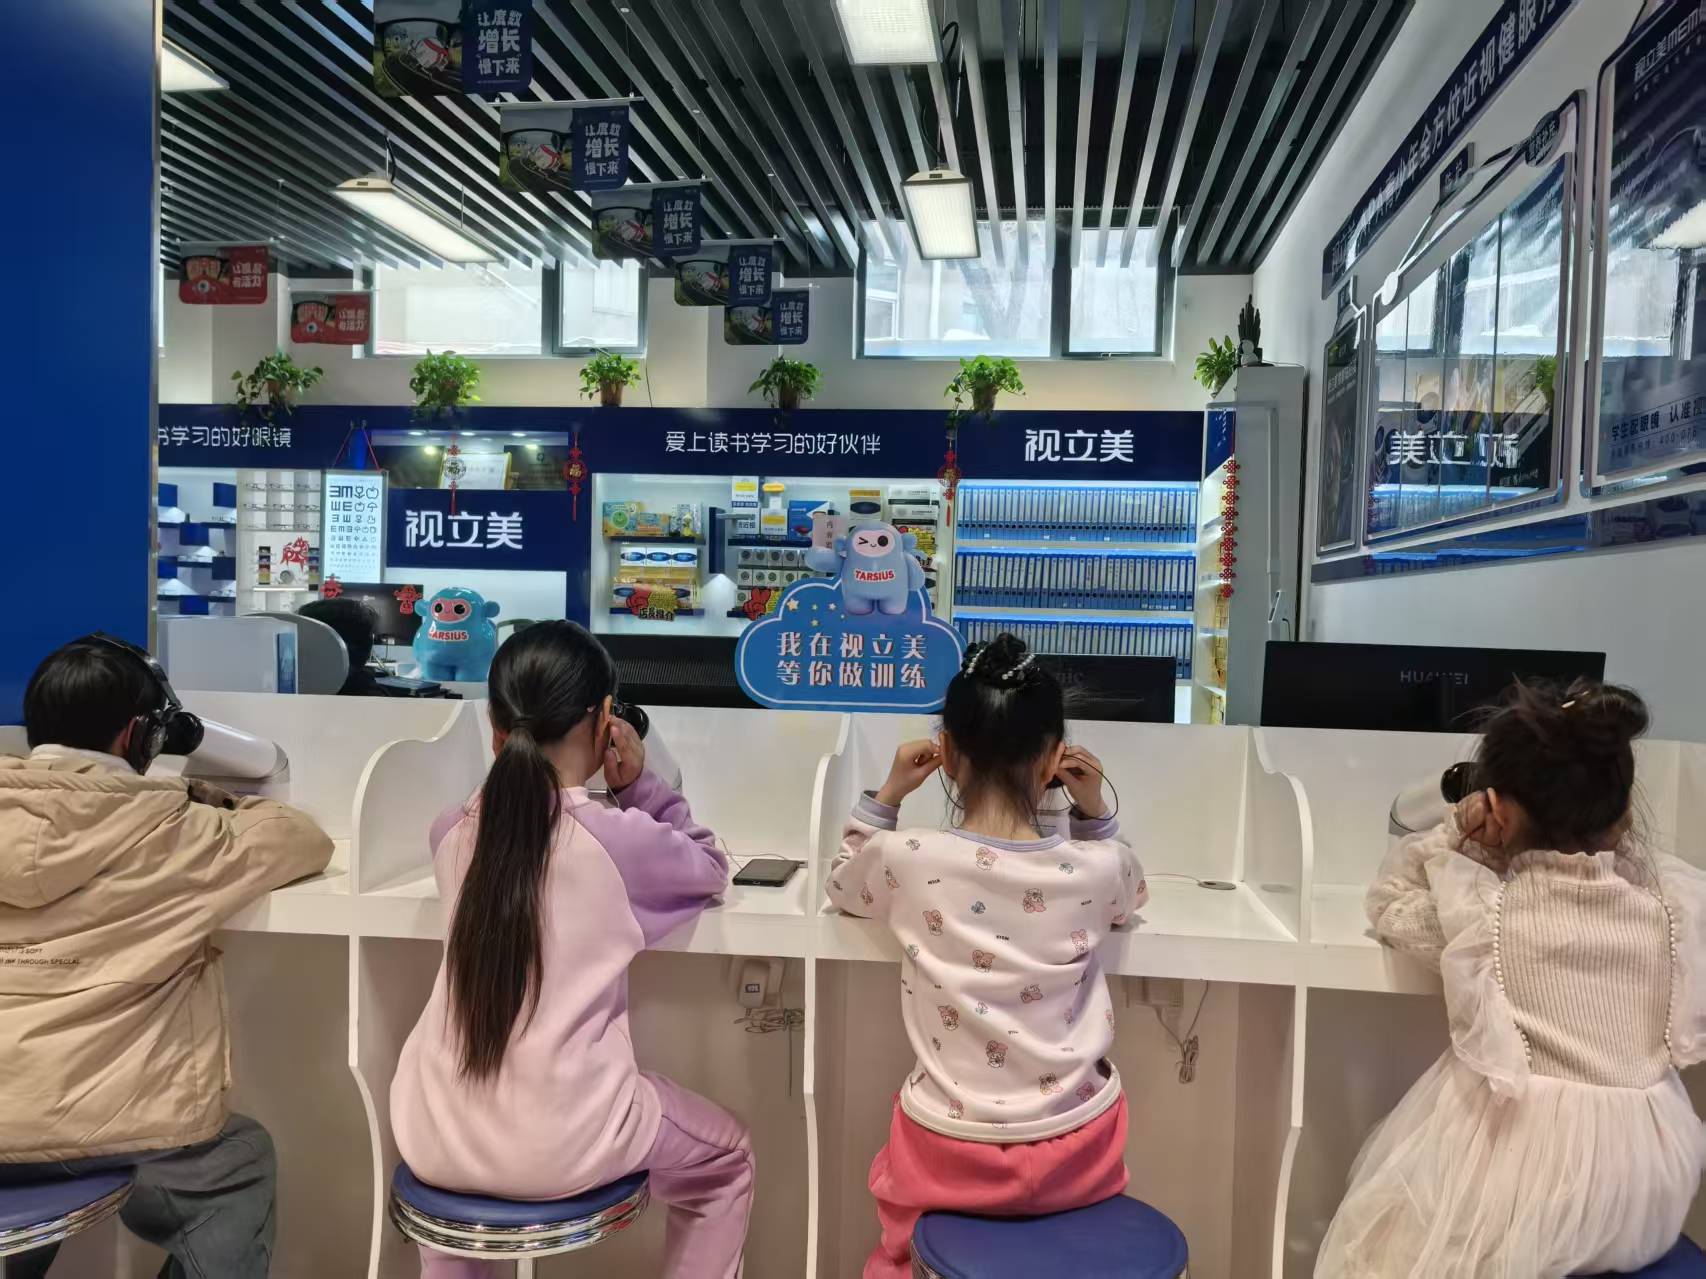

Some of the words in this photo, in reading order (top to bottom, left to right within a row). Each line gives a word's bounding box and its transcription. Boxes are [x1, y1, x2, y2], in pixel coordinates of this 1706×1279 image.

[477, 8, 523, 27] 让度数
[477, 27, 521, 54] 增长
[584, 137, 619, 159] 增长
[663, 212, 693, 230] 增长
[738, 267, 765, 282] 增长
[780, 311, 804, 324] 增长
[157, 425, 292, 448] 书学习的好眼镜
[664, 430, 882, 456] 爱上读书学习的好伙伴
[1024, 428, 1135, 463] 视立美
[404, 508, 524, 551] 视立美
[855, 569, 895, 582] TARSIUS
[776, 631, 927, 660] 我在视立美
[776, 662, 927, 689] 等你做训练
